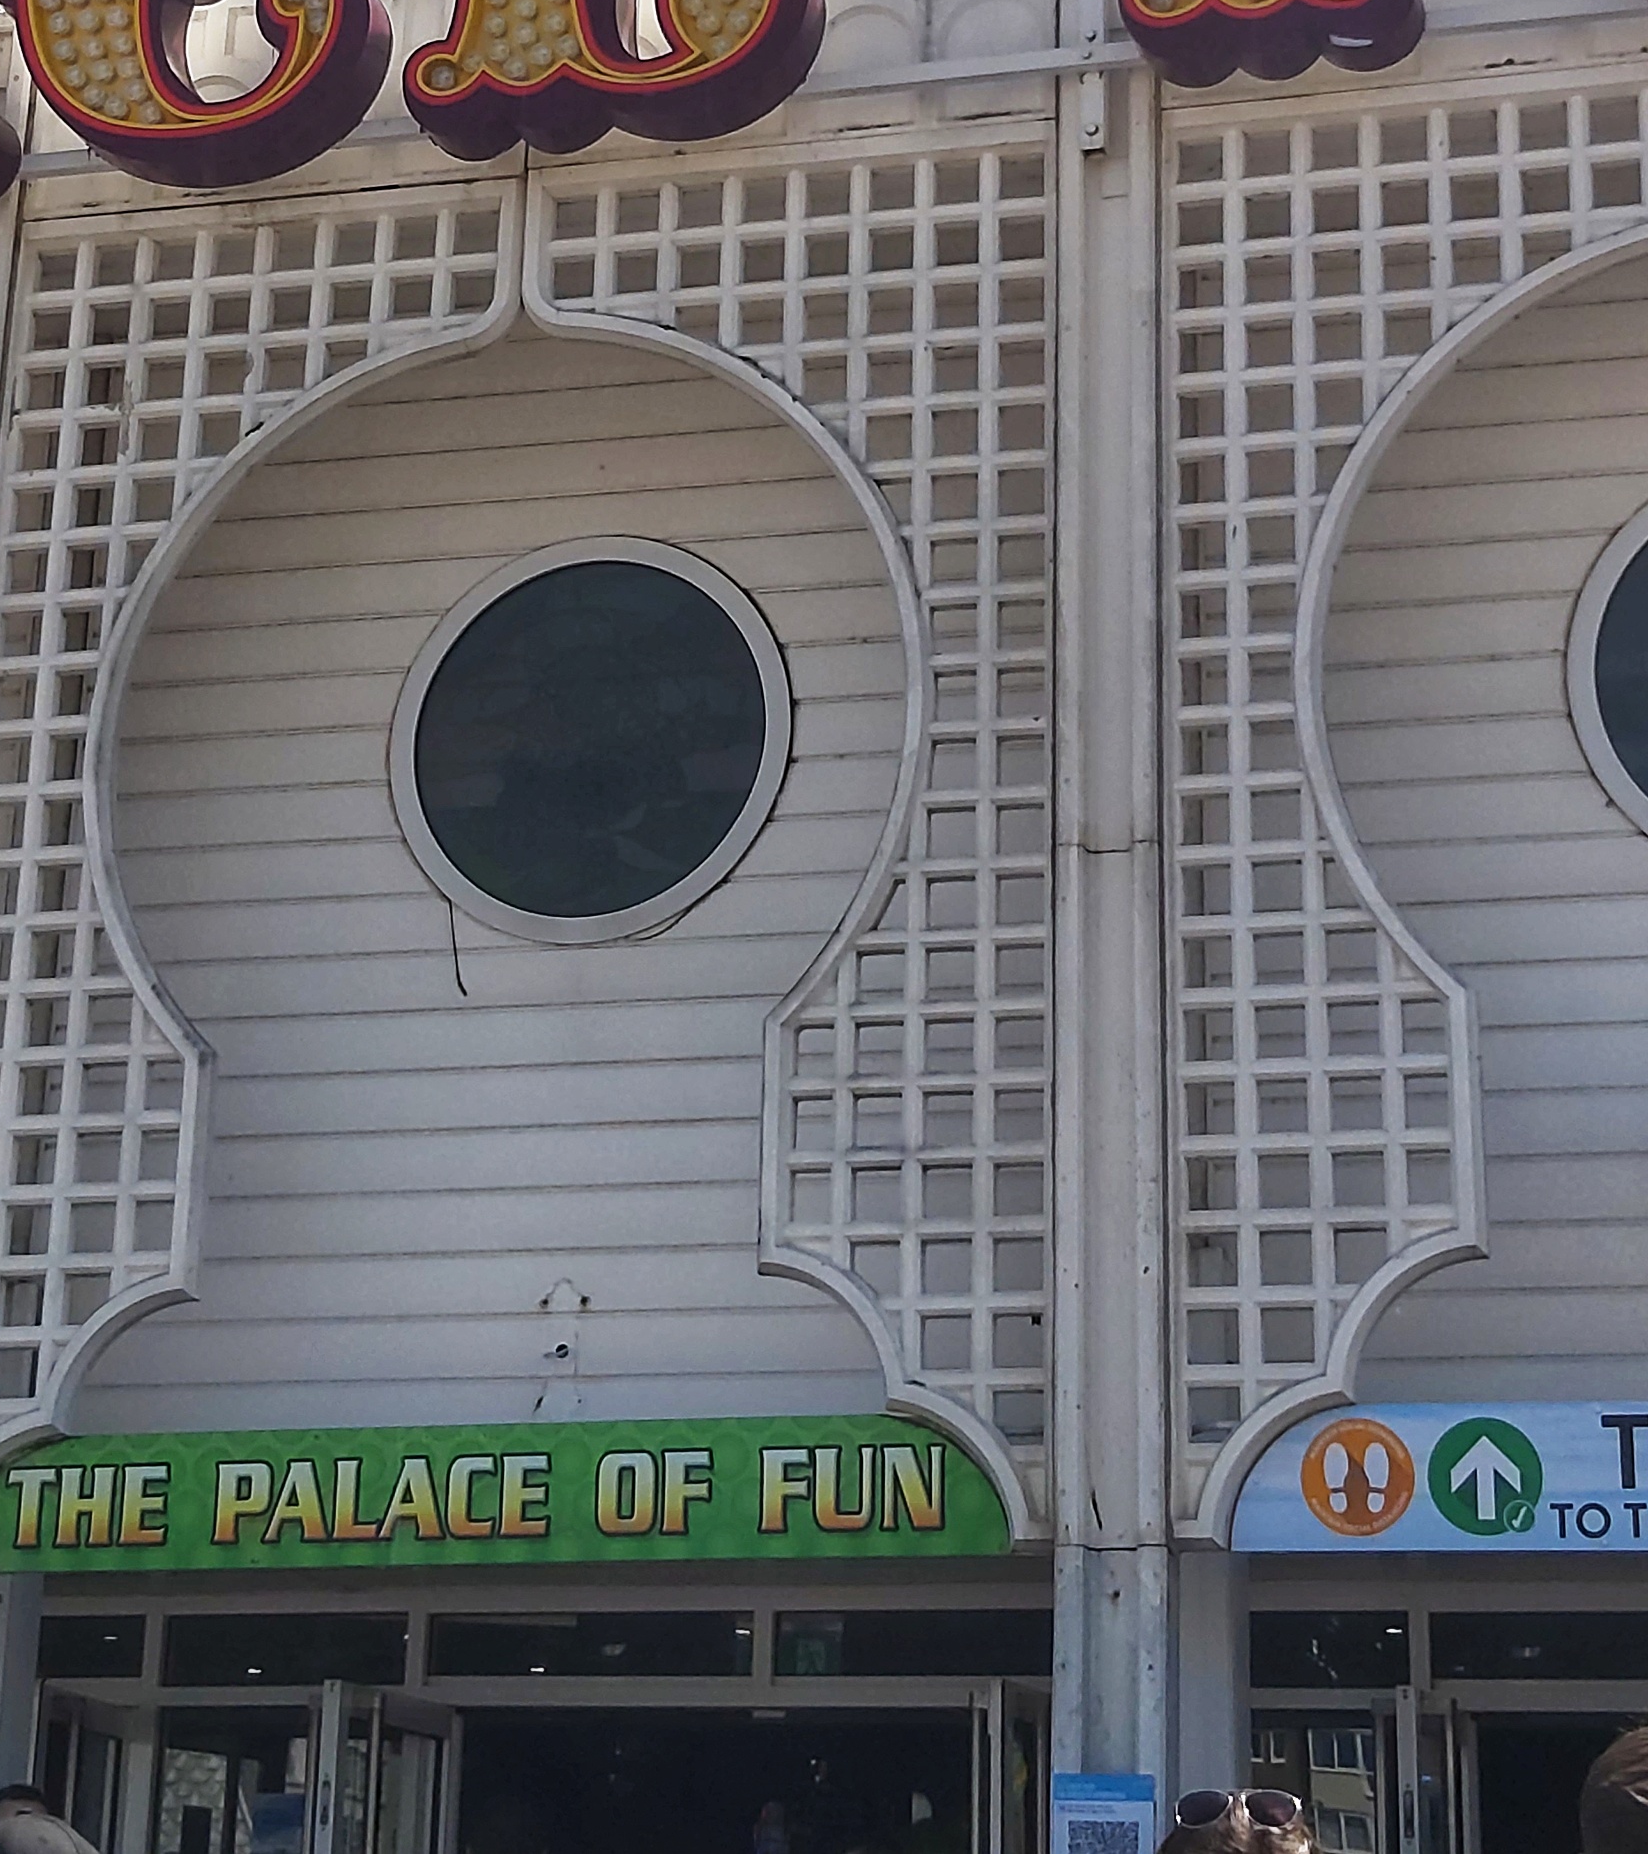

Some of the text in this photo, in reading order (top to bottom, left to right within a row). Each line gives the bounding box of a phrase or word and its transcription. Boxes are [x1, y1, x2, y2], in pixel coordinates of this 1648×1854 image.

[5, 1444, 946, 1548] THE PALACE OF FUN
[1549, 1502, 1612, 1539] TO
